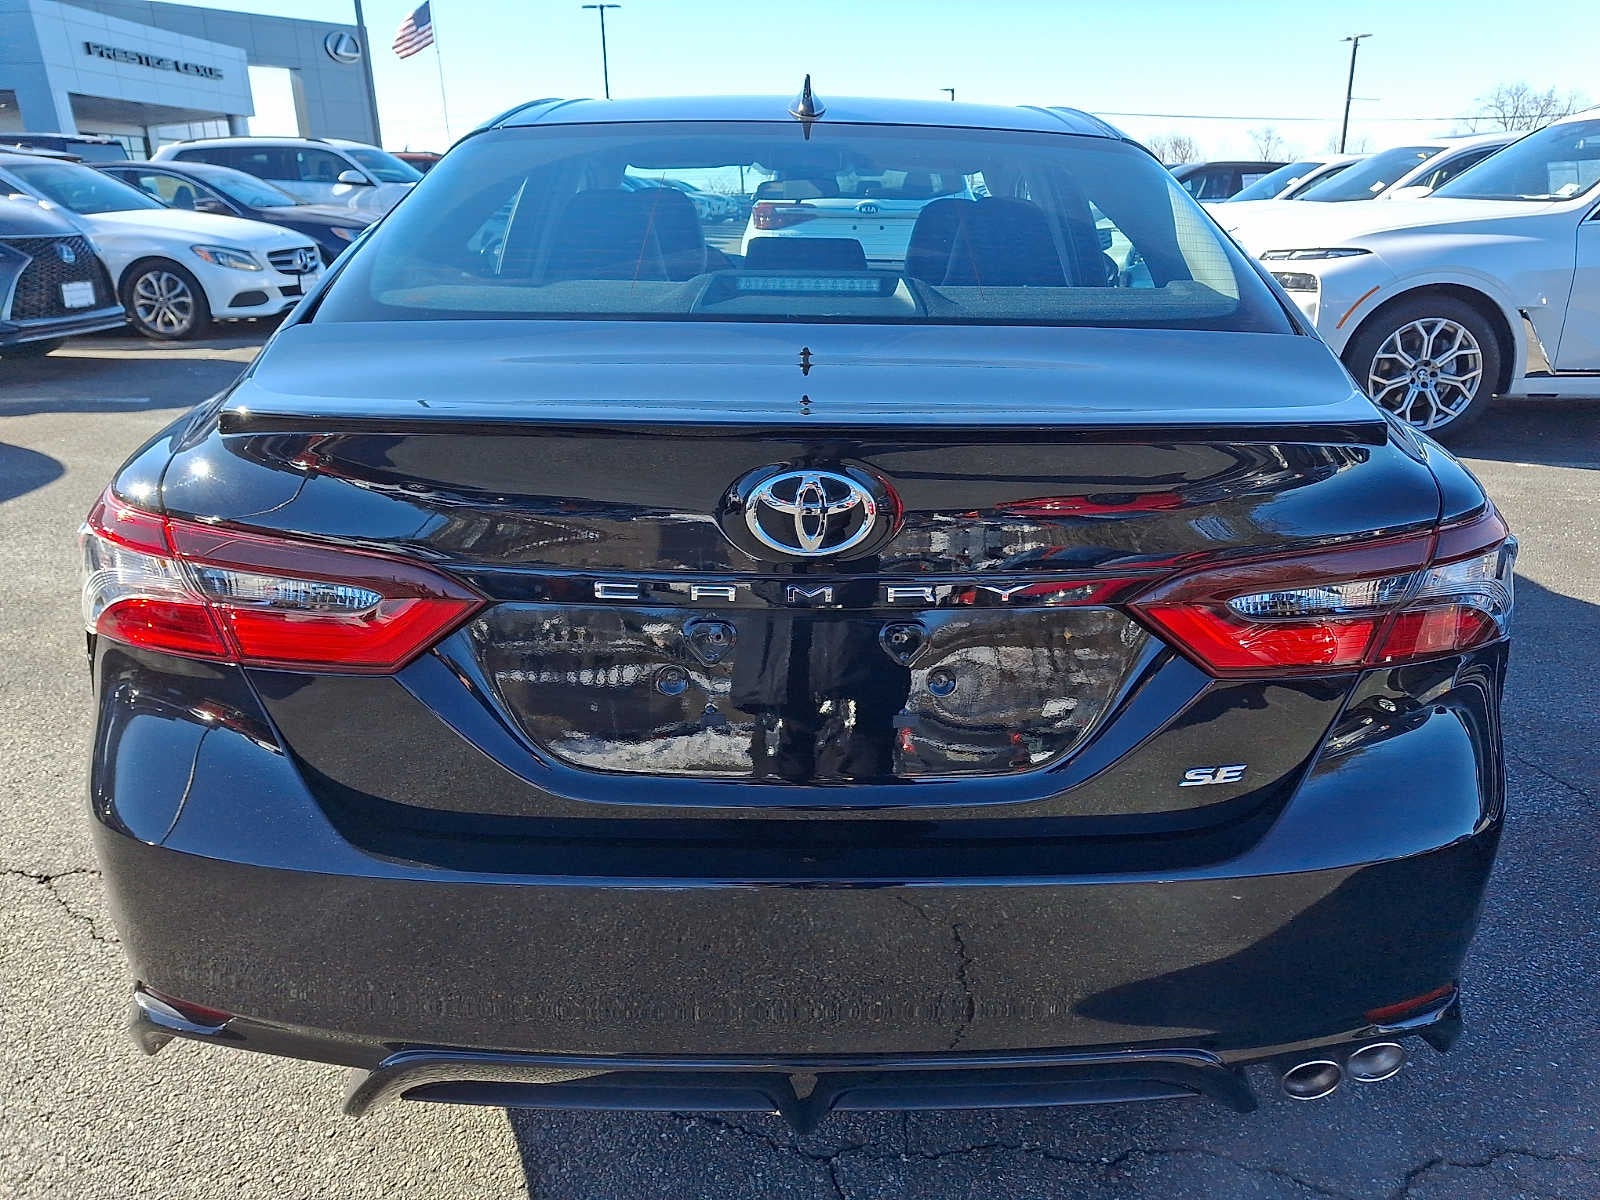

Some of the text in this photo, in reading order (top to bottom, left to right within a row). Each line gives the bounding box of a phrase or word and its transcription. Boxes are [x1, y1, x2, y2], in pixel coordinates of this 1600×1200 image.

[84, 41, 223, 80] PRESTIGE LEXUS
[861, 205, 878, 214] KIA
[593, 579, 1036, 603] CAMRY
[1178, 763, 1247, 787] SE
